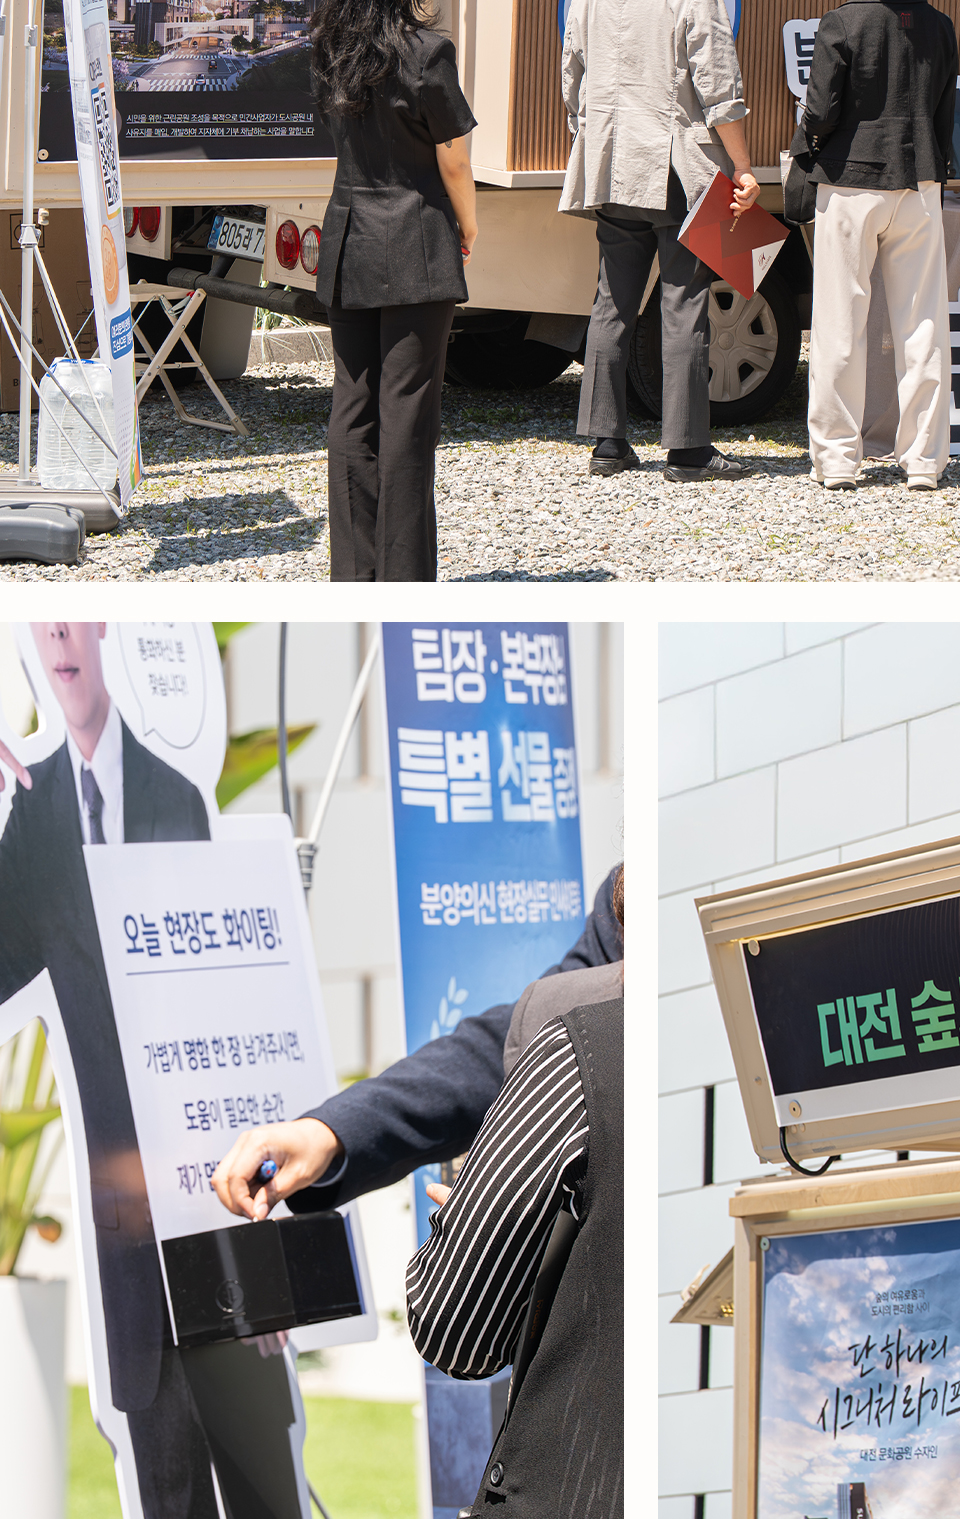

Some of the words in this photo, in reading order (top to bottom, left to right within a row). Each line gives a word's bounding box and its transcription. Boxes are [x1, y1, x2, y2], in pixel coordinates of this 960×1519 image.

[218, 221, 254, 251] 805라
[253, 228, 265, 256] 7
[398, 727, 493, 824] 특별
[498, 729, 557, 823] 선물
[123, 913, 163, 957] 오늘
[163, 909, 222, 955] 현장도
[222, 905, 283, 952] 화이팅!
[144, 1039, 185, 1074] 가볍게
[183, 1036, 211, 1071] 명함
[211, 1034, 227, 1068] 한
[227, 1031, 242, 1067] 장
[241, 1029, 305, 1066] 남겨주시면,
[816, 988, 907, 1068] 대전
[184, 1099, 225, 1132] 도움이
[223, 1094, 261, 1129] 필요한
[261, 1091, 285, 1124] 순간
[176, 1163, 205, 1195] 제가
[848, 1334, 878, 1378] 단
[880, 1328, 949, 1378] 하나의
[816, 1382, 898, 1440] 시그니처
[860, 1448, 878, 1462] 대전
[878, 1446, 913, 1461] 문화공원
[913, 1445, 938, 1459] 수자인
